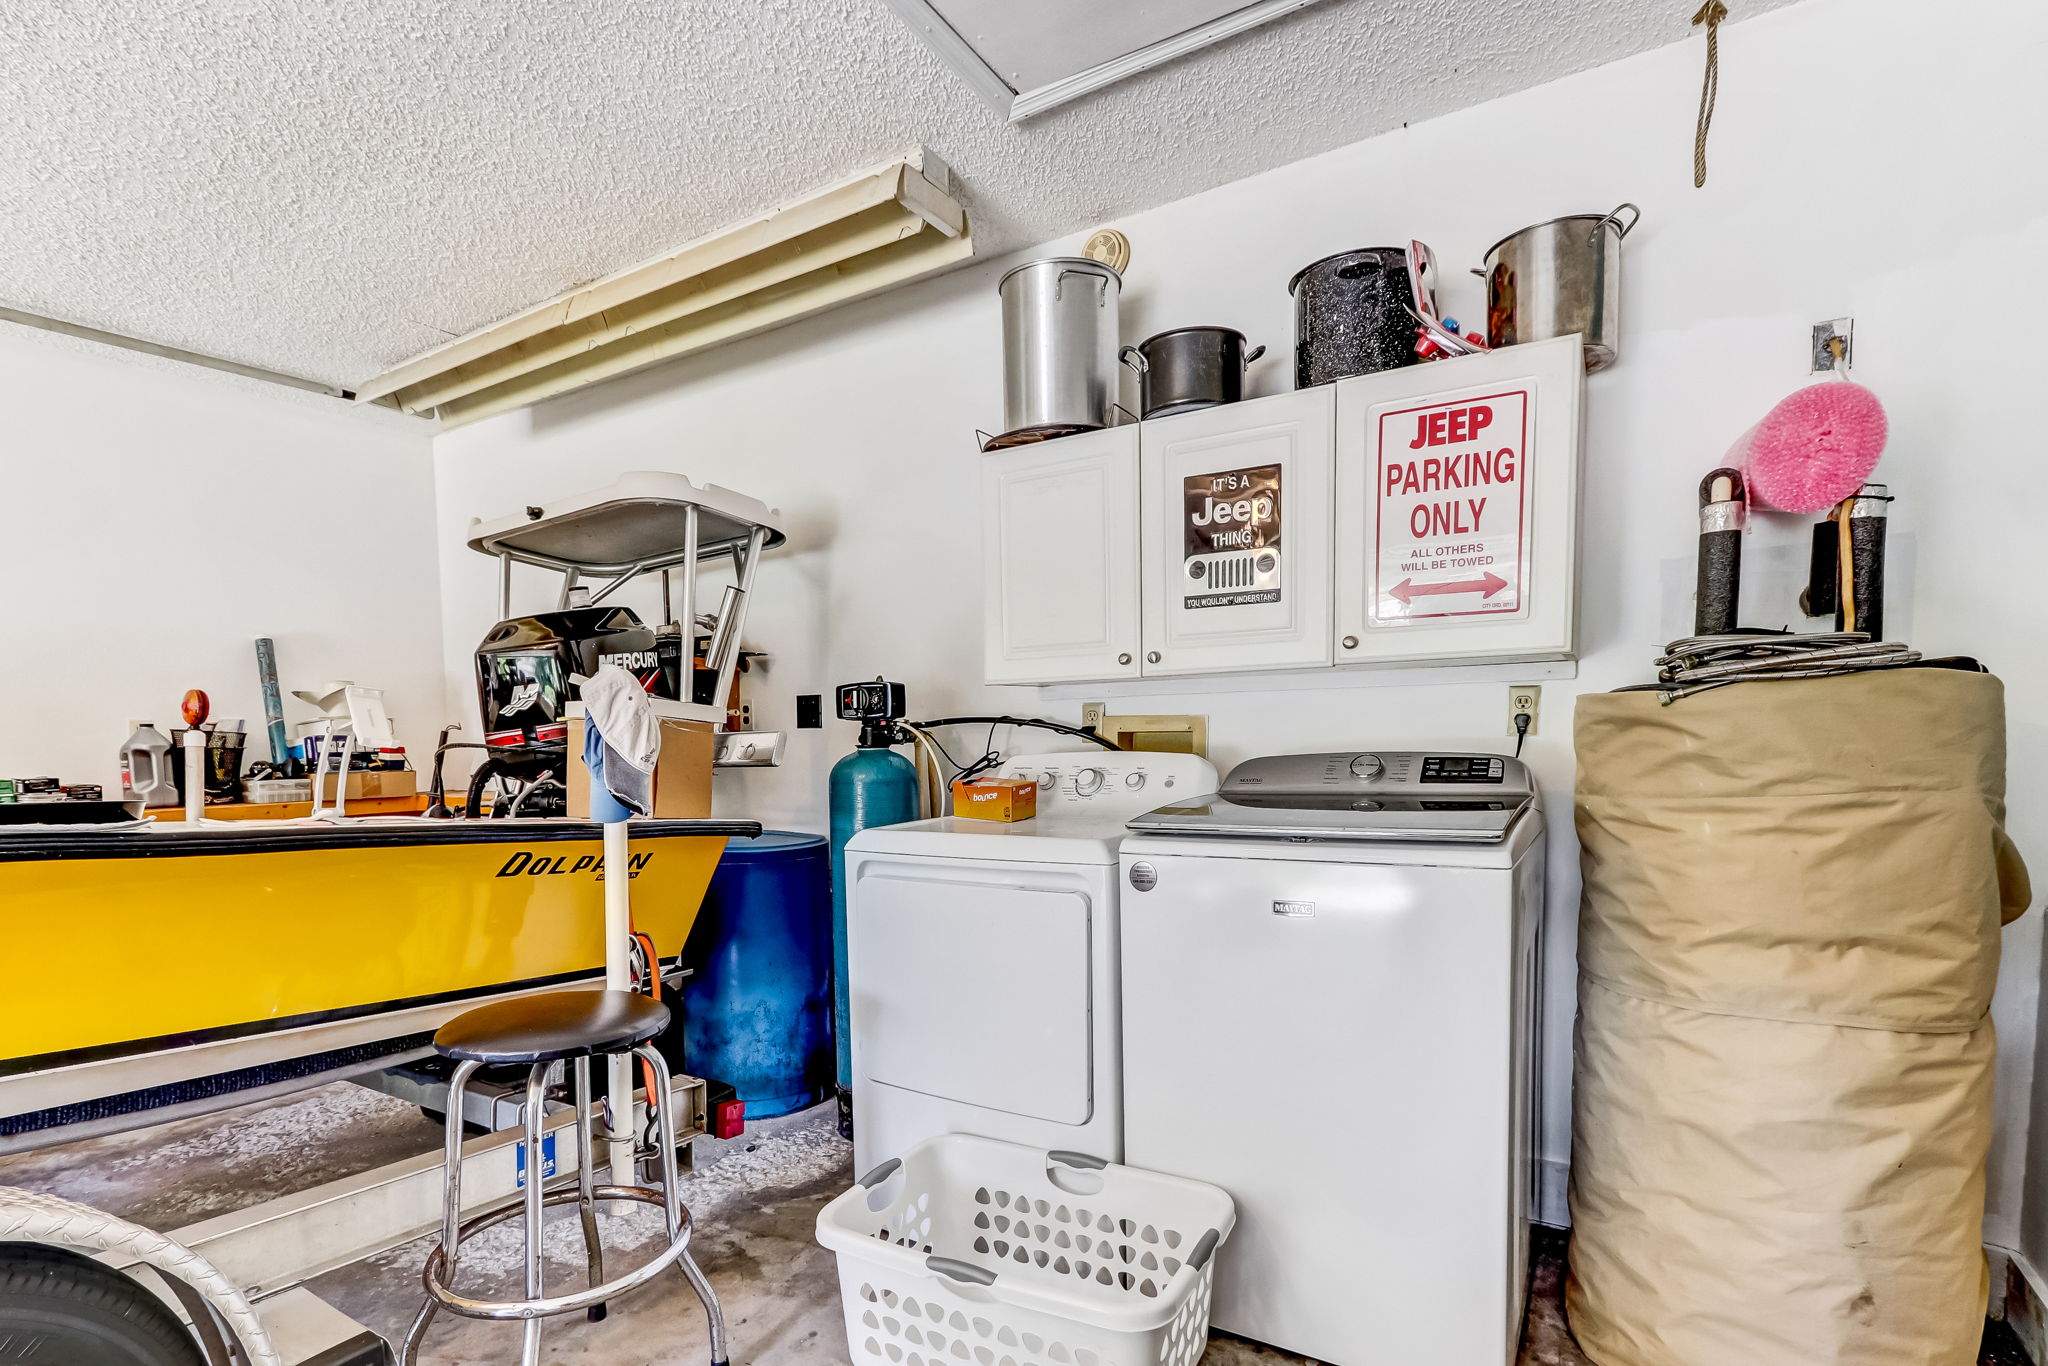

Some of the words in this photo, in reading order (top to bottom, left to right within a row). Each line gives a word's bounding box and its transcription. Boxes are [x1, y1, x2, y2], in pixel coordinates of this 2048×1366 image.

[1409, 405, 1493, 449] JEEP
[1386, 447, 1515, 497] PARKING
[1212, 476, 1237, 492] IT'S
[1240, 475, 1250, 488] A
[1191, 496, 1272, 526] Jeep
[1410, 497, 1487, 539] ONLY
[1211, 530, 1252, 547] THING
[1410, 548, 1432, 559] ALL
[1435, 543, 1484, 556] OTHERS
[1401, 561, 1428, 572] WILL
[1431, 559, 1447, 570] BE
[1450, 555, 1494, 568] TOWED
[598, 651, 659, 671] MERCURY
[973, 792, 998, 802] bounce
[495, 851, 654, 877] DOLPN
[1274, 903, 1312, 913] MAYTAG
